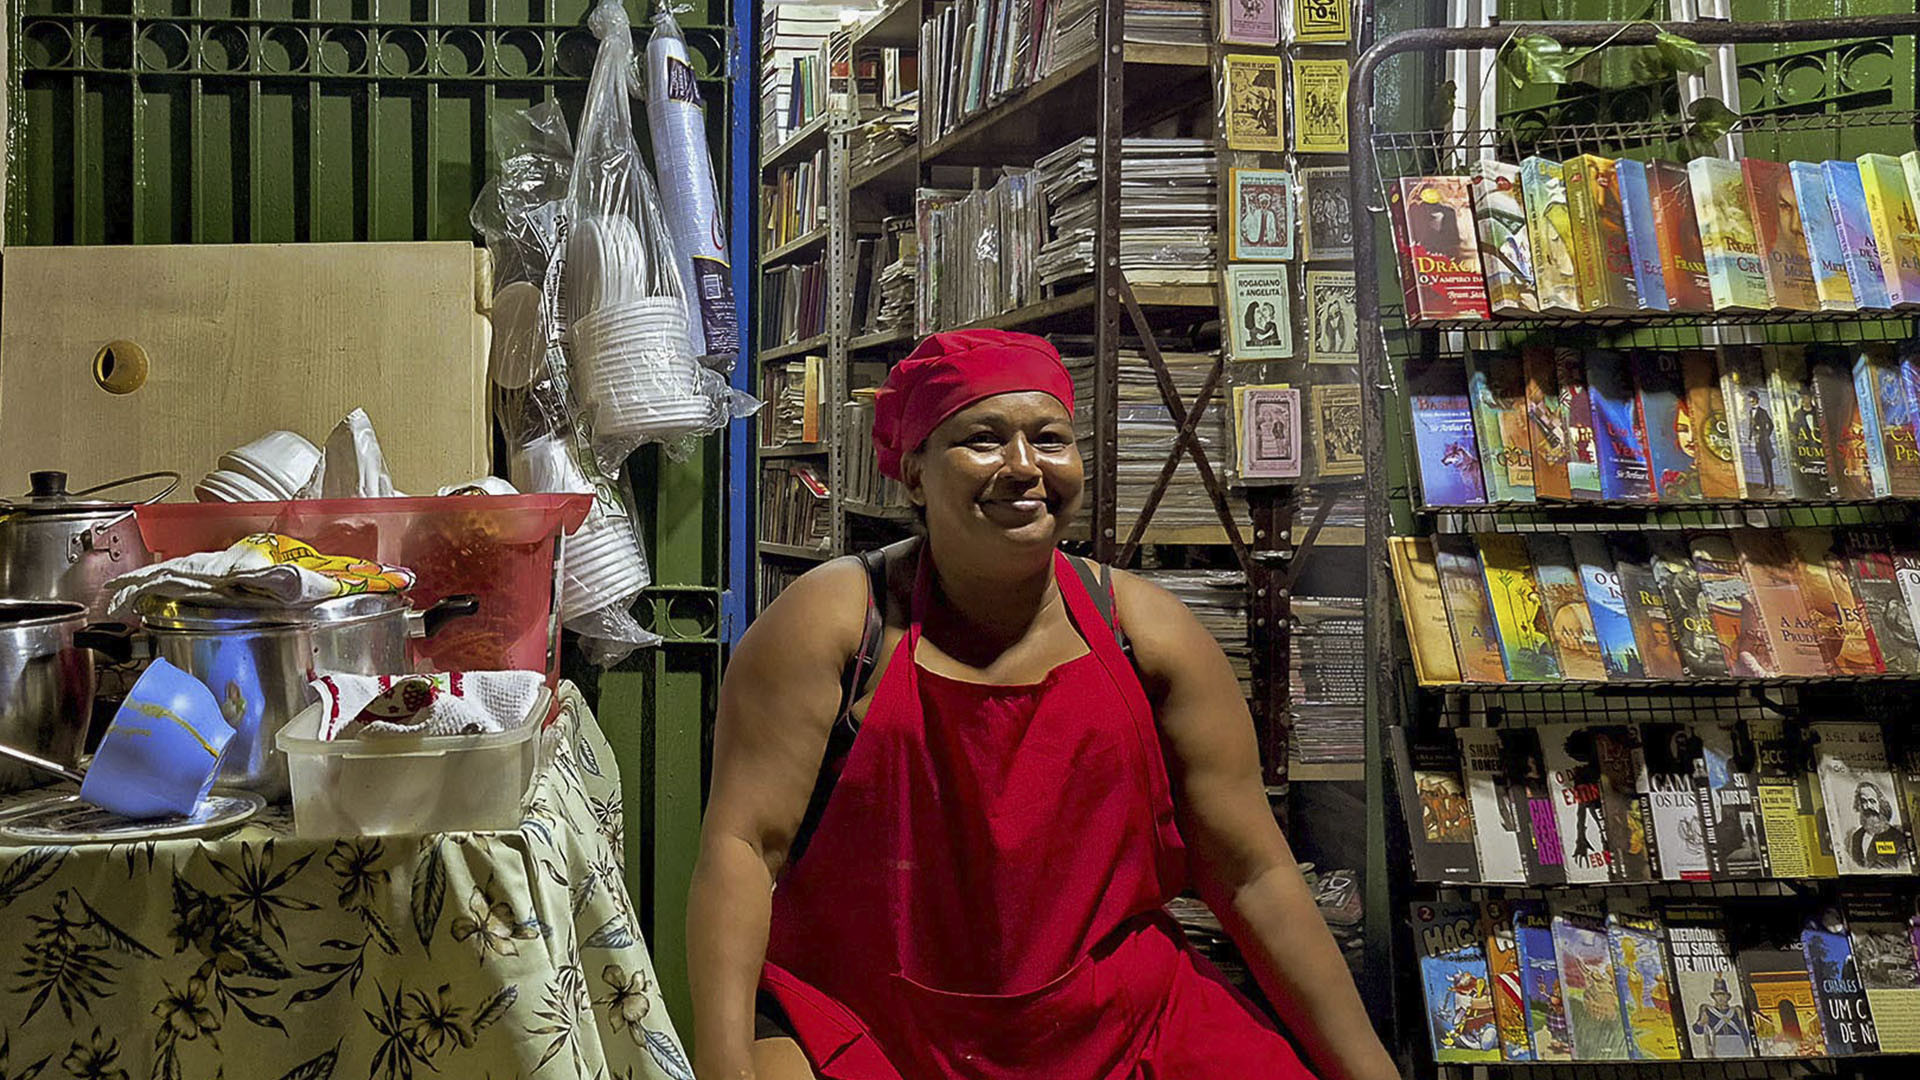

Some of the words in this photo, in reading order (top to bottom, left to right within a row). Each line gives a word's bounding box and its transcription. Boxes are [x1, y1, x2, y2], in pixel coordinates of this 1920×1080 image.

[1246, 288, 1280, 296] ANGELITA
[1798, 427, 1809, 440] A
[1595, 573, 1606, 585] O
[1780, 617, 1791, 628] A
[1471, 626, 1482, 637] A
[1656, 796, 1673, 808] OS
[1420, 907, 1432, 920] 2
[1671, 943, 1690, 956] UM
[1674, 957, 1692, 972] DE
[1823, 980, 1857, 994] CHARLES
[1828, 999, 1852, 1020] UM
[1855, 999, 1866, 1019] C
[1840, 1023, 1858, 1044] DE
